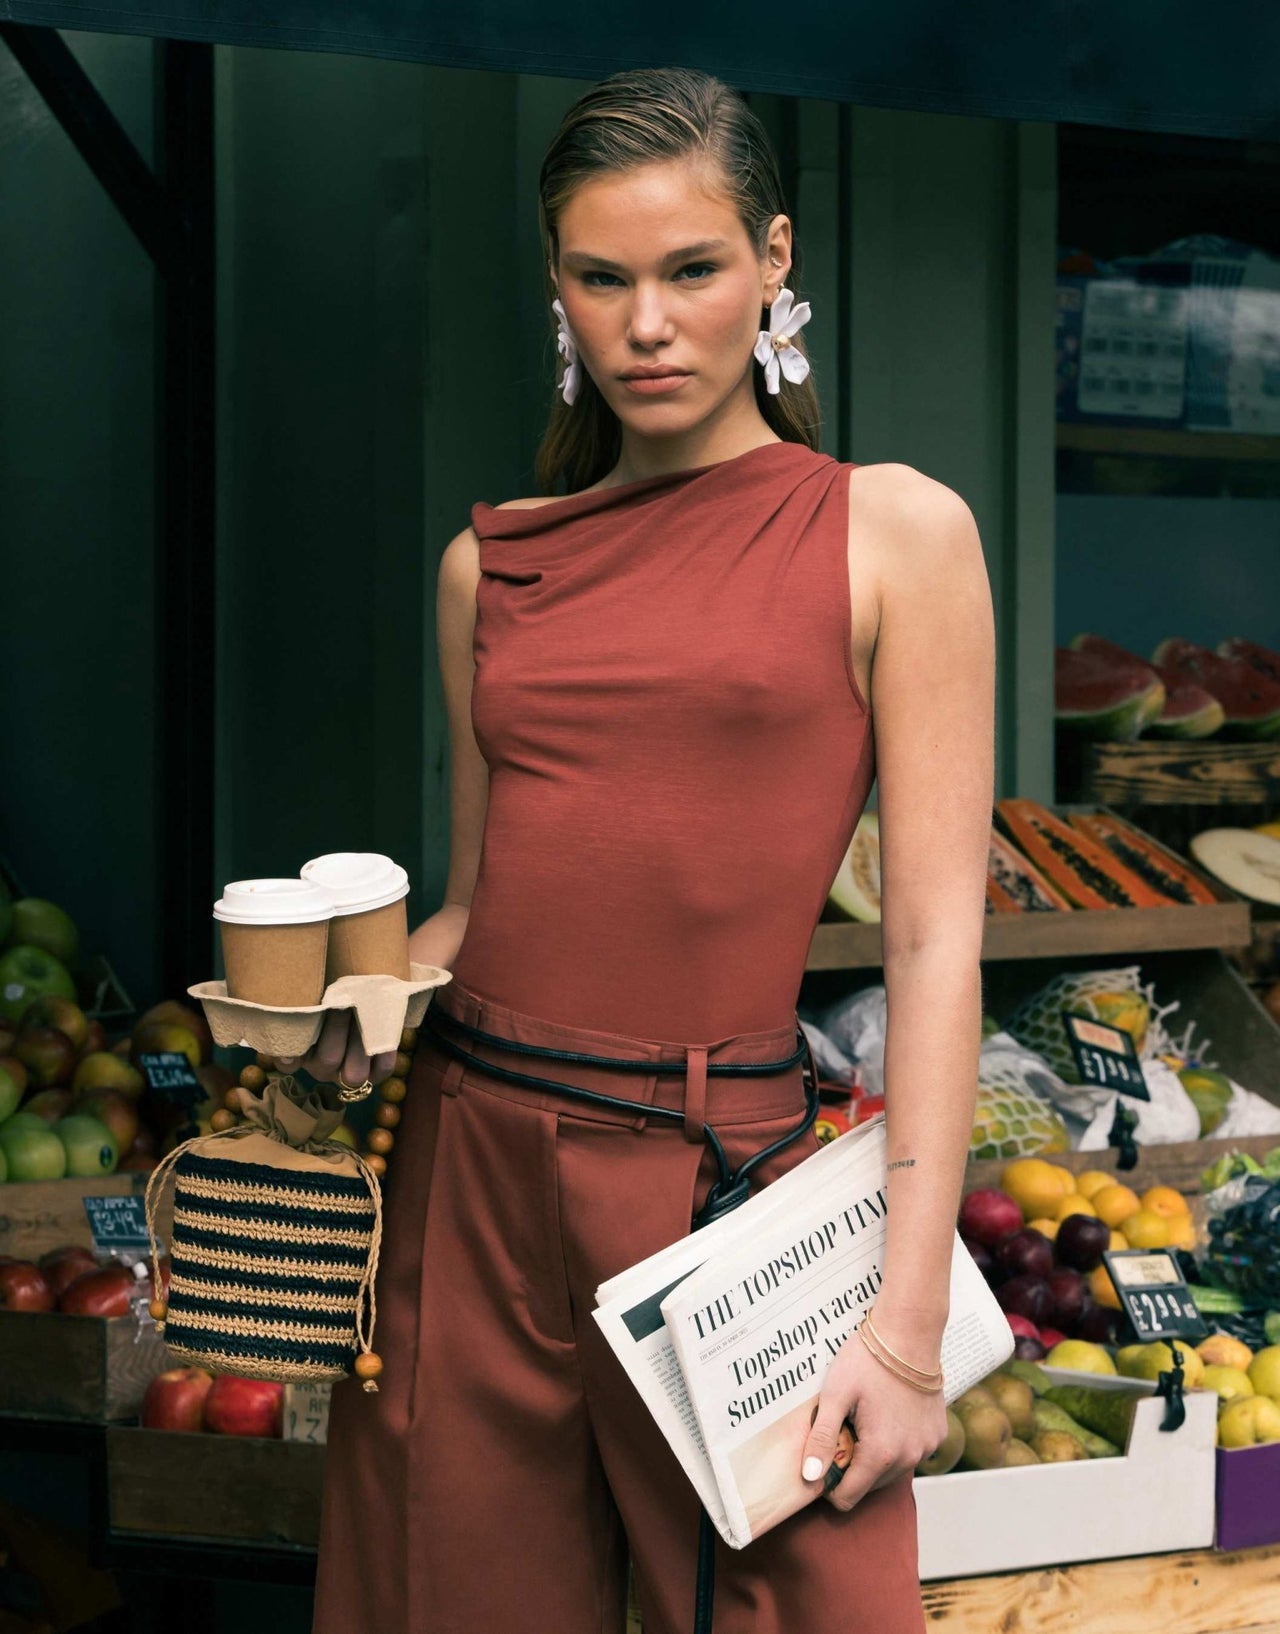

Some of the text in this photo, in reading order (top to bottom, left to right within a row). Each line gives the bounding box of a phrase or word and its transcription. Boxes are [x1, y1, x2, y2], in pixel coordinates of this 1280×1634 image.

[688, 1289, 742, 1340] THE
[738, 1221, 837, 1306] TOPSHOP
[727, 1315, 818, 1387] Topshop
[727, 1353, 817, 1428] Summer
